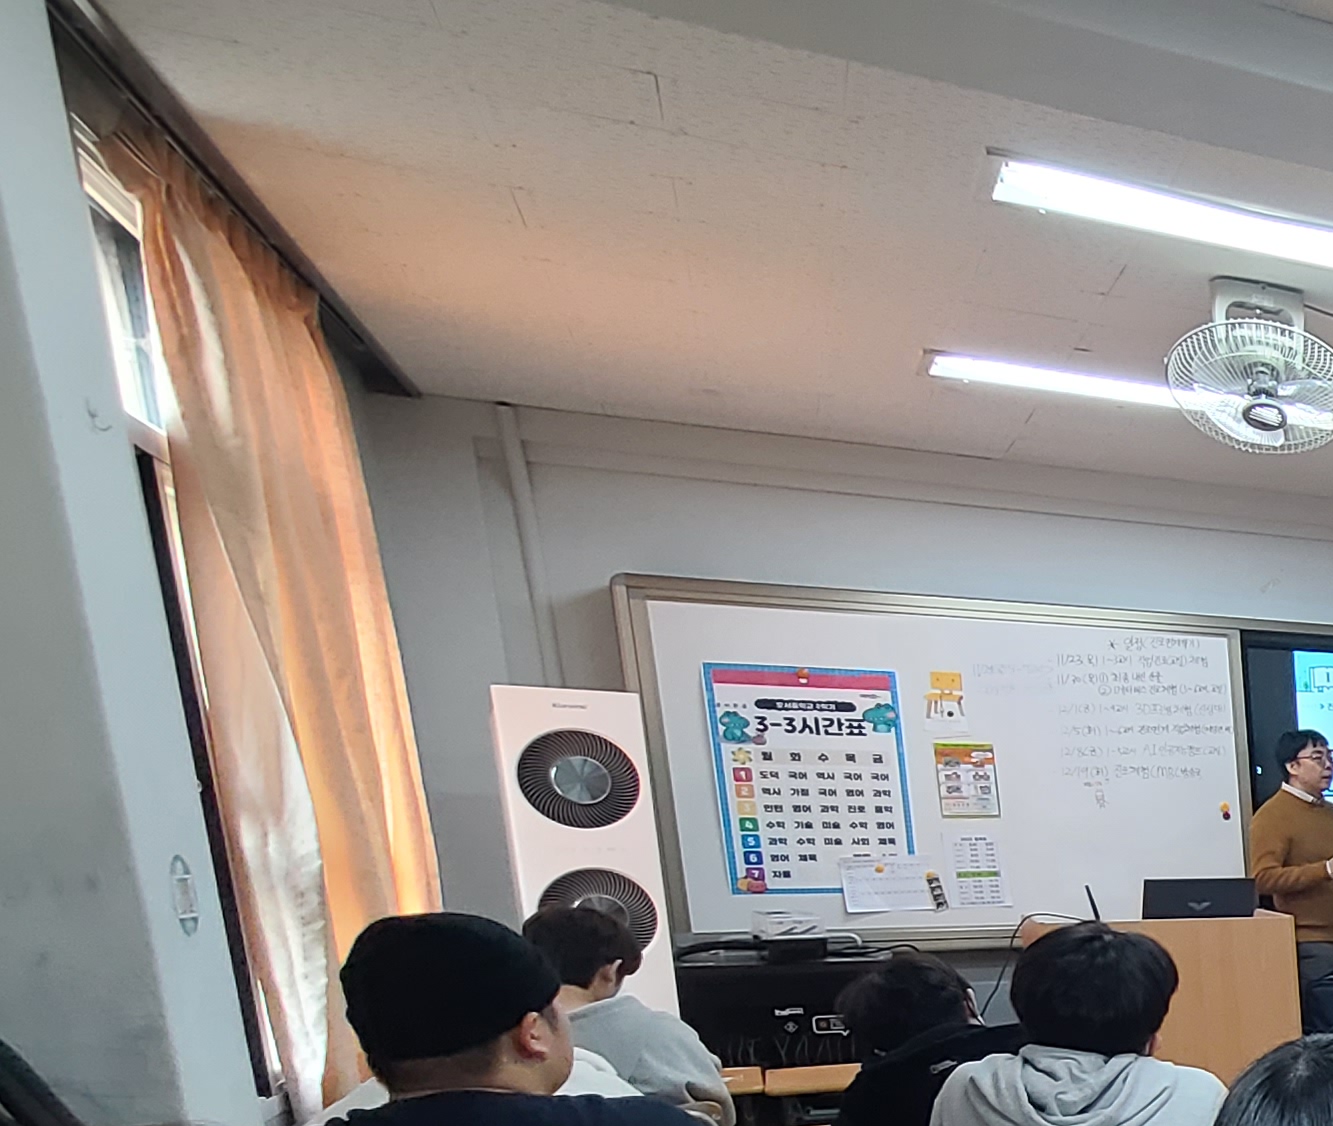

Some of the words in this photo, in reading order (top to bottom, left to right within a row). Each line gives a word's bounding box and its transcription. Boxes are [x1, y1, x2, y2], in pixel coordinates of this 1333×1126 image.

[754, 715, 868, 737] 3-3시간표
[818, 752, 829, 762] 수
[759, 770, 779, 780] 도덕
[788, 771, 808, 780] 국어
[843, 772, 862, 781] 국어
[871, 772, 890, 782] 국어
[818, 787, 837, 797] 국어
